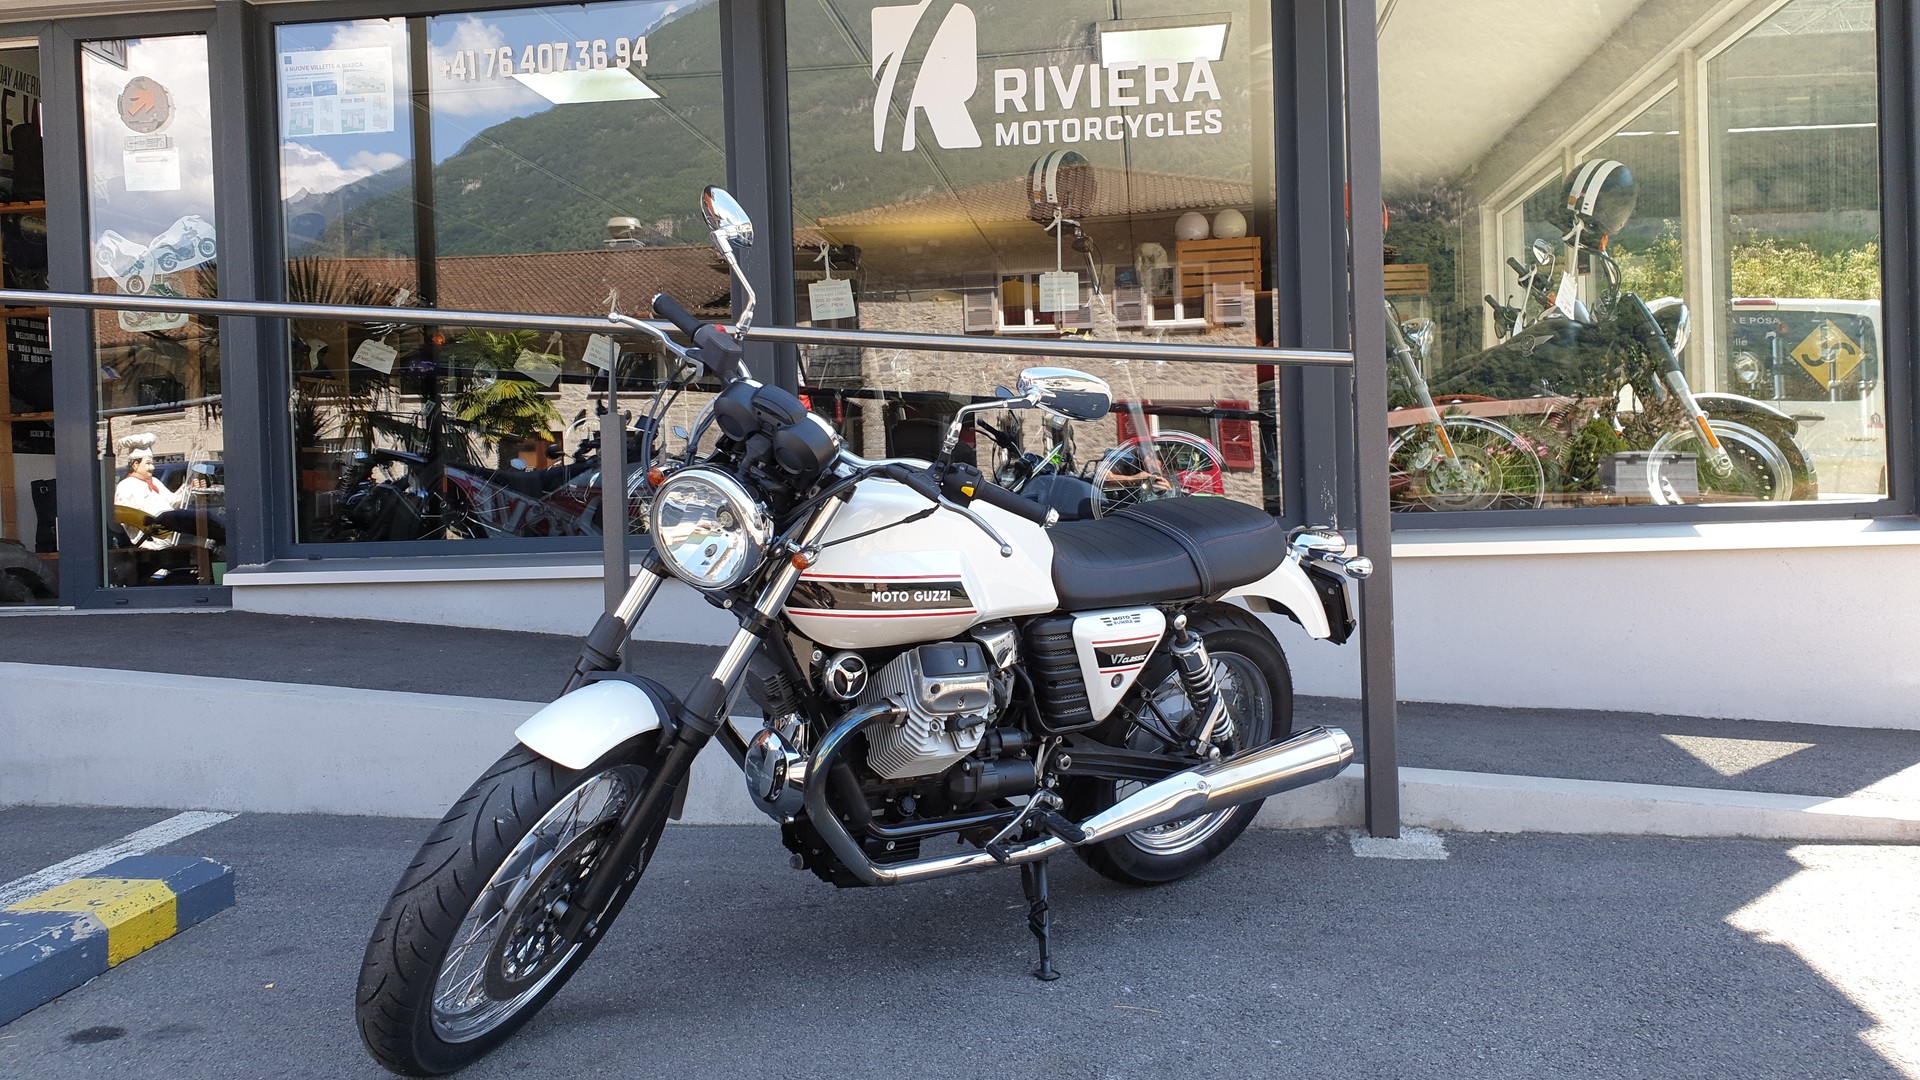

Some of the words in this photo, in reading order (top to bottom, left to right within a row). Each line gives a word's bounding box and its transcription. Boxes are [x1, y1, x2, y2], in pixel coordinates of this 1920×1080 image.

[442, 50, 476, 80] +41
[484, 46, 513, 78] 76
[520, 43, 569, 75] 407
[576, 39, 608, 72] 36
[616, 36, 648, 69] 94
[995, 57, 1222, 113] RIVIERA
[996, 109, 1222, 147] MOTORCYCLES
[871, 590, 909, 602] MOTO
[914, 590, 951, 602] GUZZI
